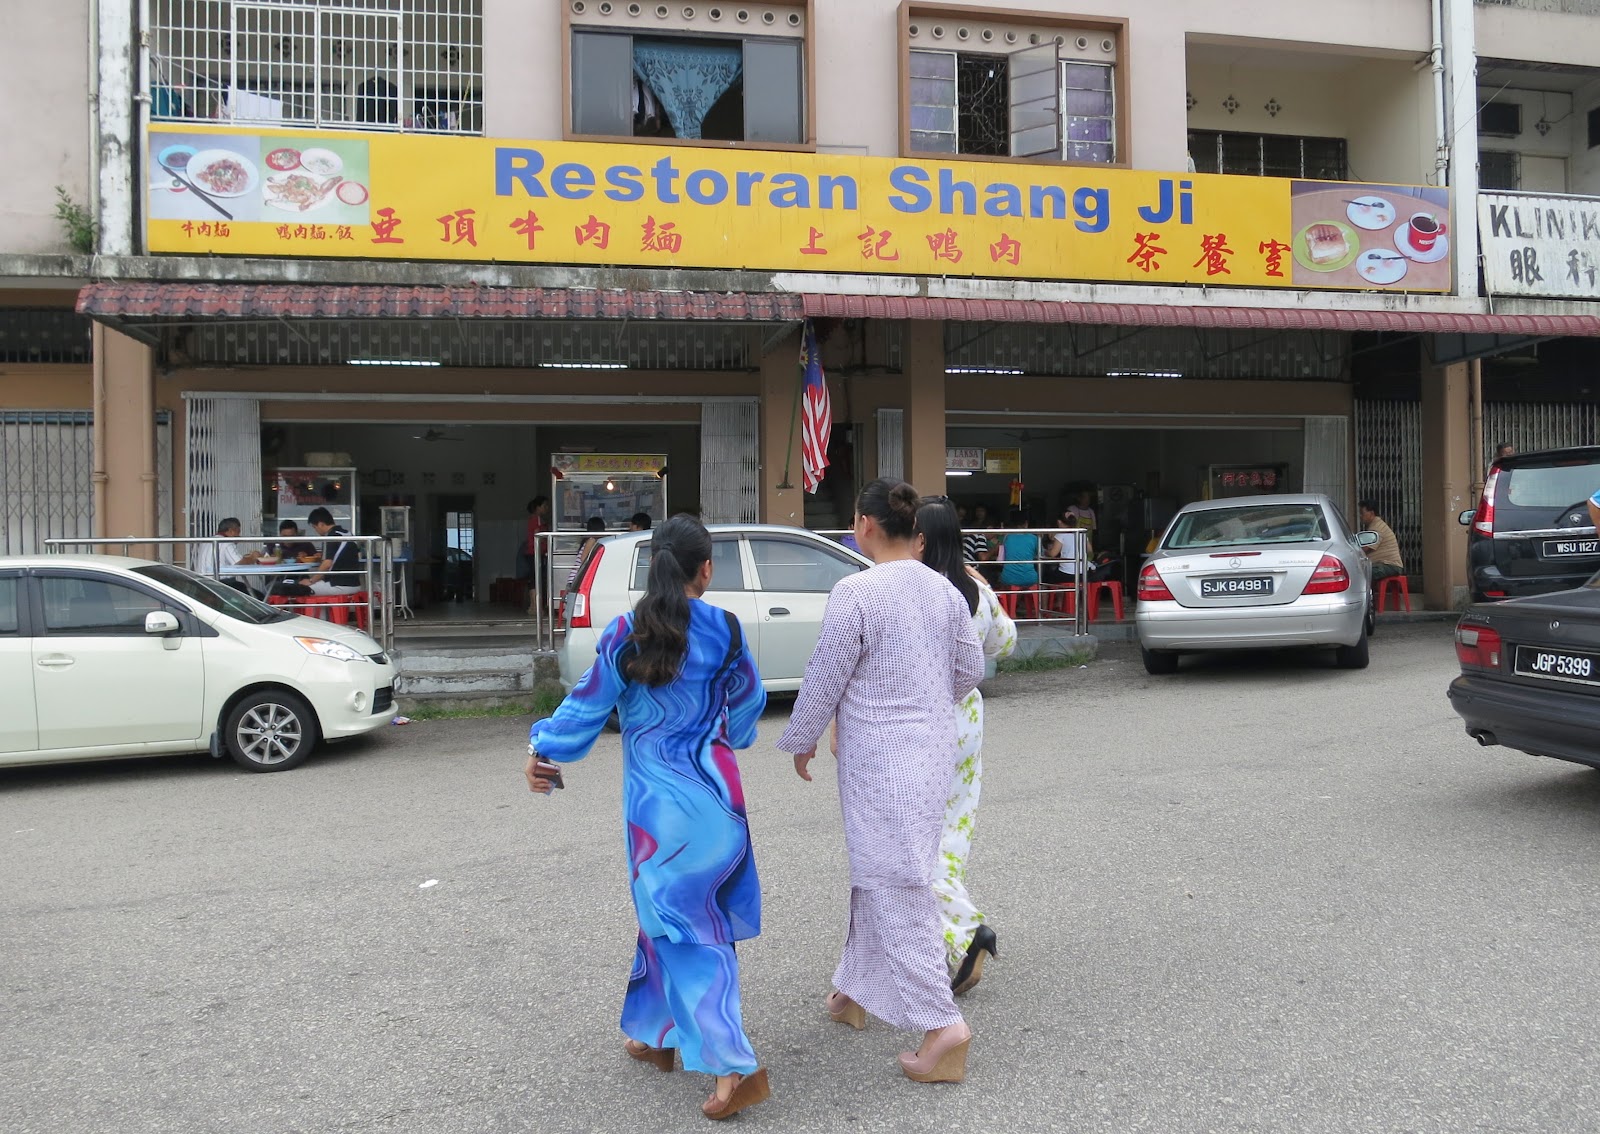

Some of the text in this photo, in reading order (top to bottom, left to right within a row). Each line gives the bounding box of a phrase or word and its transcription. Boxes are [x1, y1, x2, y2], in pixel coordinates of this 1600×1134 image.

[495, 147, 1193, 233] Restoran Shang Ji
[181, 220, 230, 238] 牛肉麵
[1489, 204, 1600, 240] KLINIK
[1126, 232, 1291, 278] 茶餐室
[954, 449, 978, 458] LAKSA
[1556, 541, 1598, 553] WSU 1127
[1532, 653, 1591, 677] JGP 5399
